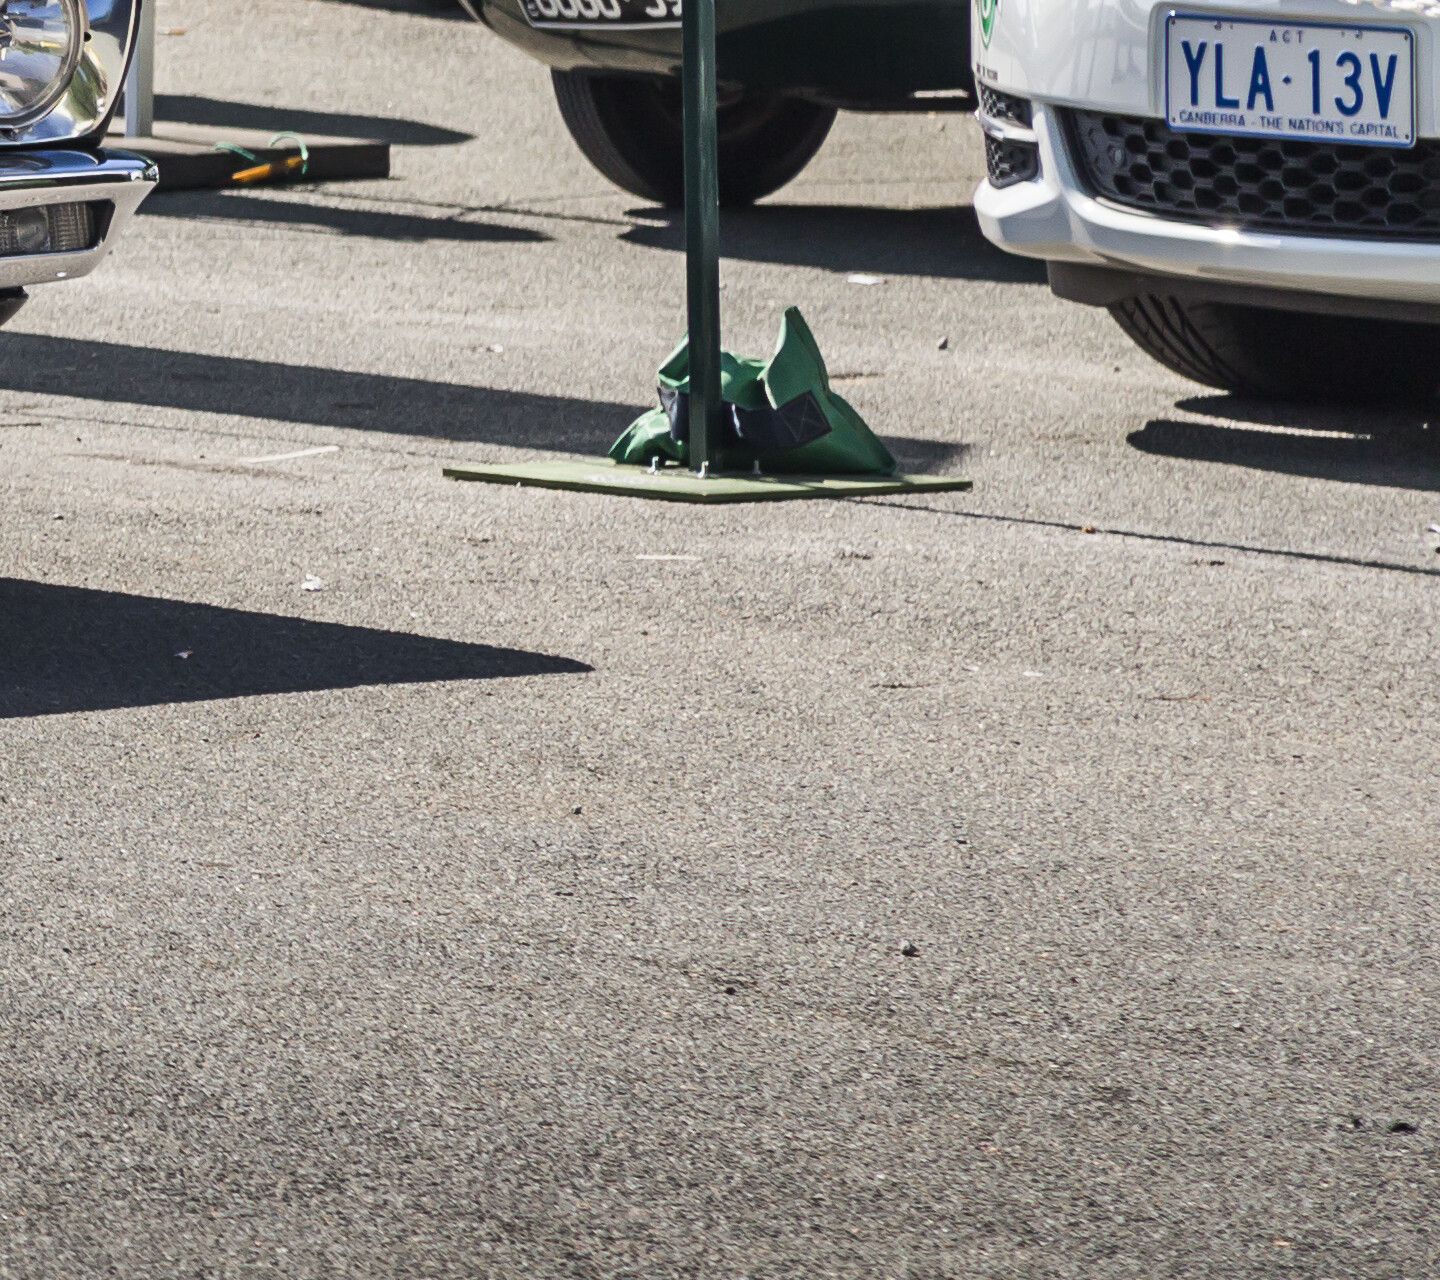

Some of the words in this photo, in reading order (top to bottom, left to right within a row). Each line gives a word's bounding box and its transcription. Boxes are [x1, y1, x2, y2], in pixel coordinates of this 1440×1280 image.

[1269, 28, 1305, 44] ACT
[1179, 109, 1246, 127] CANBERRA
[1260, 115, 1284, 130] THE
[1288, 117, 1345, 135] NATION'S
[1350, 121, 1399, 139] CAPITAL
